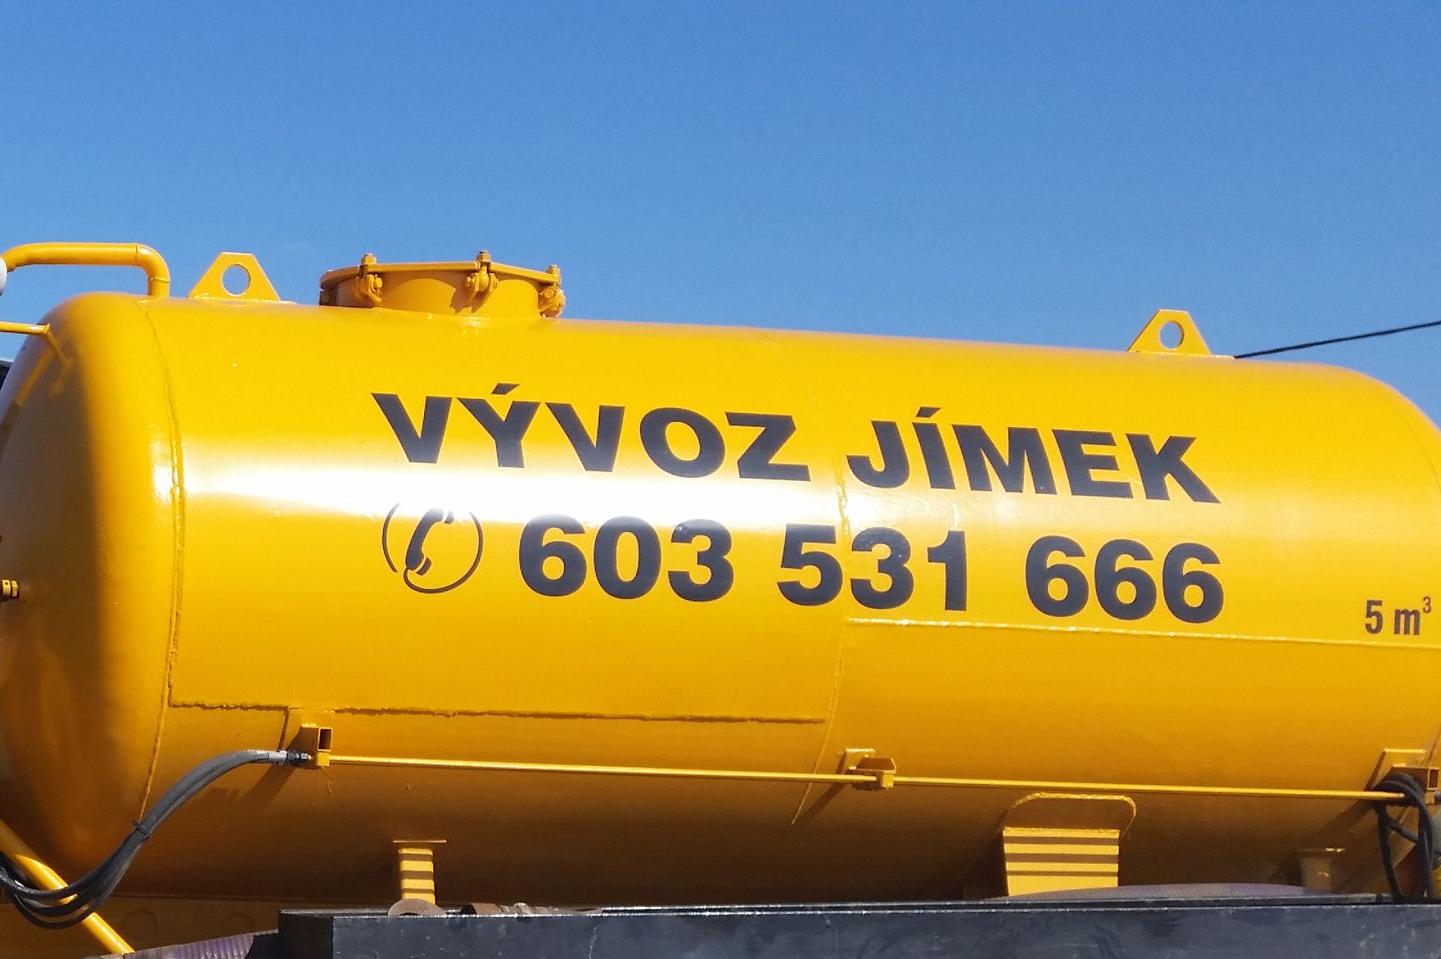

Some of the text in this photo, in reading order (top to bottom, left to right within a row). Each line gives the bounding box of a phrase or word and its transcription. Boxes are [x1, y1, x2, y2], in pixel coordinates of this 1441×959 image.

[371, 382, 1221, 504] VÝVOZ JÍMEK
[518, 514, 1224, 624] 603 531 666
[1364, 599, 1384, 635] 5
